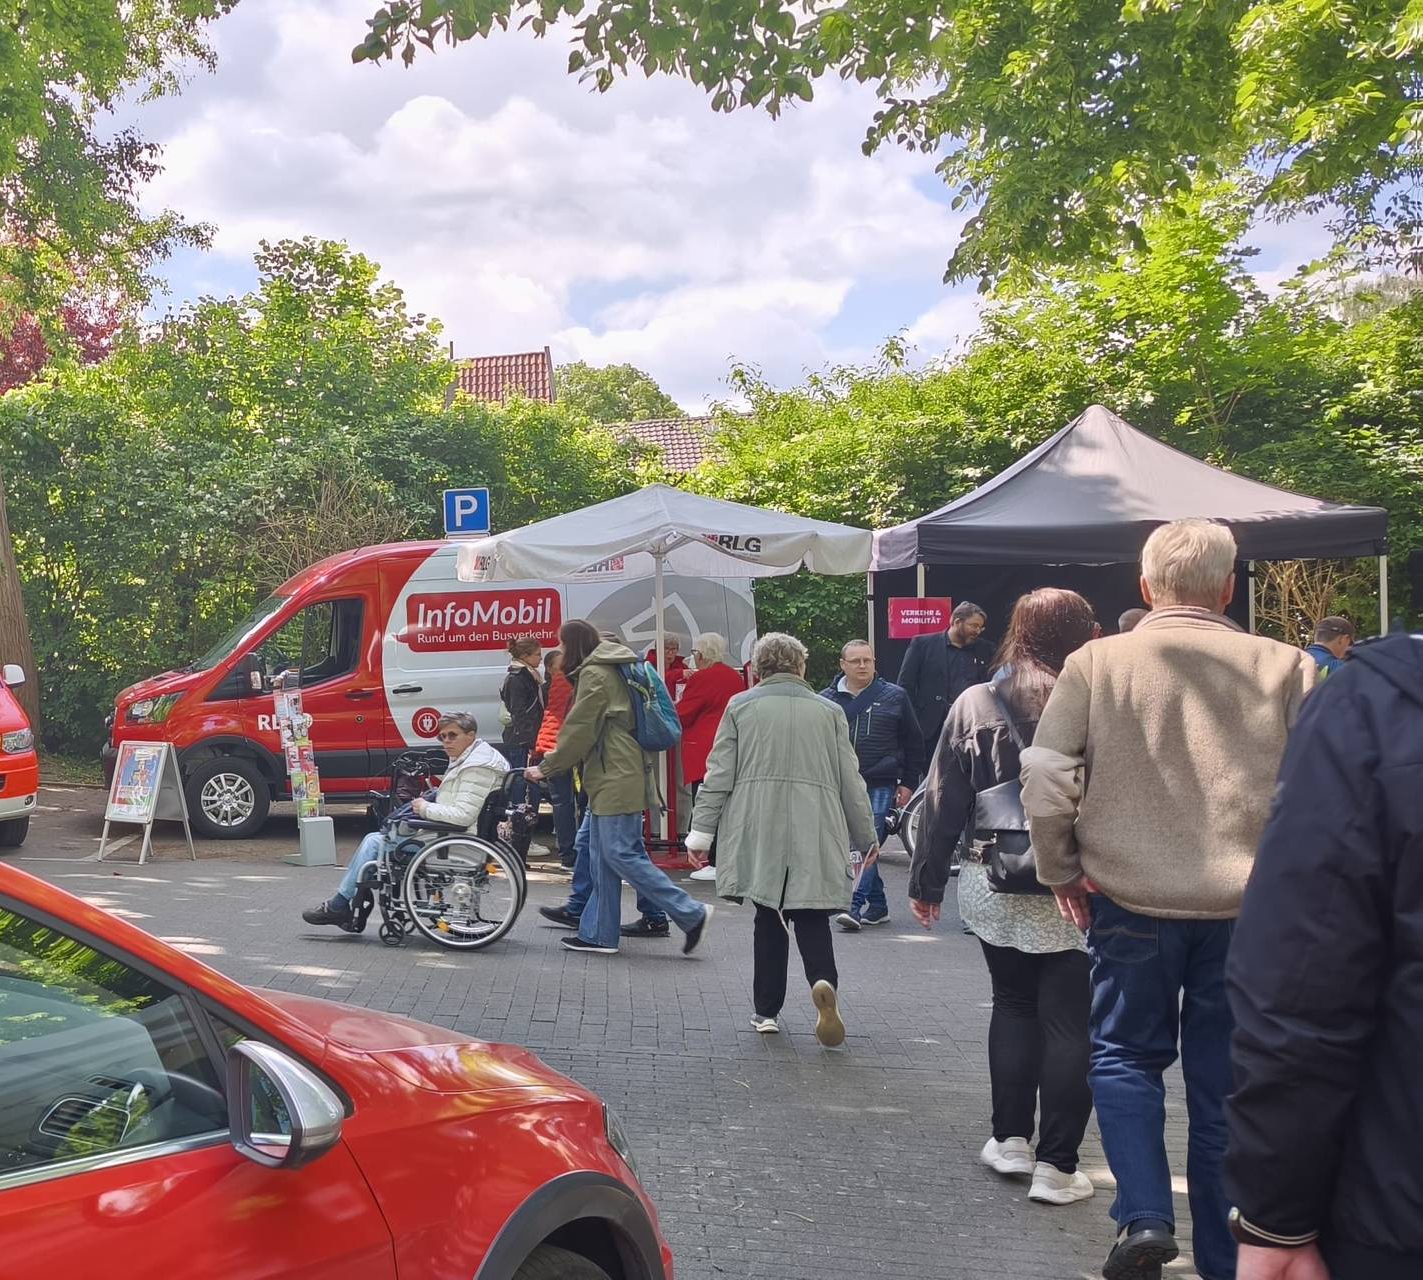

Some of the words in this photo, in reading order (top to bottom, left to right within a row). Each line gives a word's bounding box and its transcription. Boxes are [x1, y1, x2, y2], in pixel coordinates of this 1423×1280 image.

[454, 495, 478, 527] P
[718, 534, 762, 552] RLG
[417, 598, 552, 631] InfoMobil
[901, 616, 942, 624] MOBILITÄT
[417, 631, 446, 643] Rund
[448, 633, 466, 643] um
[468, 630, 489, 642] den
[492, 629, 554, 641] Busverkehr
